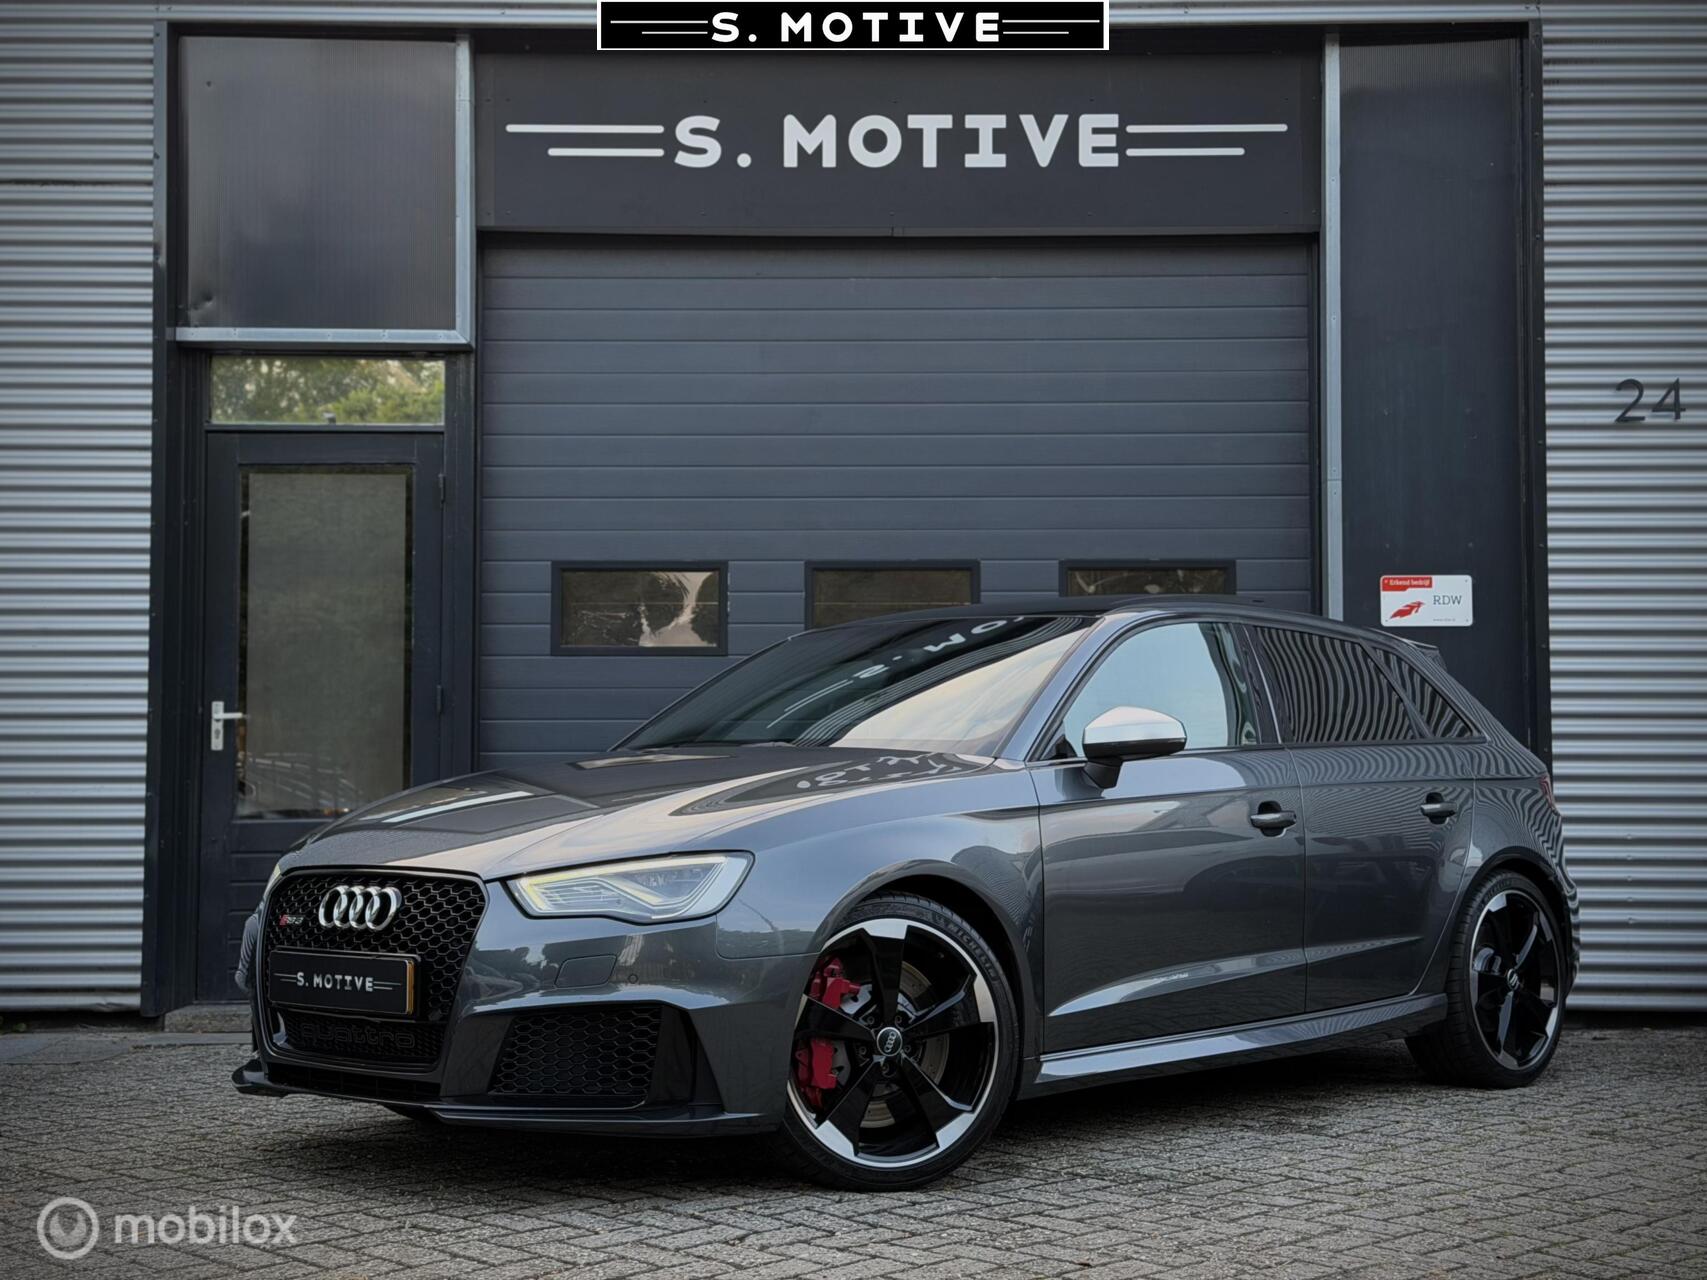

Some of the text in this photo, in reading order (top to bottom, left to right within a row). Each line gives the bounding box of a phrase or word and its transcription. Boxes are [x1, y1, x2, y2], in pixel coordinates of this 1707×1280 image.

[674, 114, 1119, 168] S. MOTIVE
[1614, 378, 1687, 422] 24
[1433, 595, 1462, 605] RDW
[296, 971, 374, 992] S. MOTIVE
